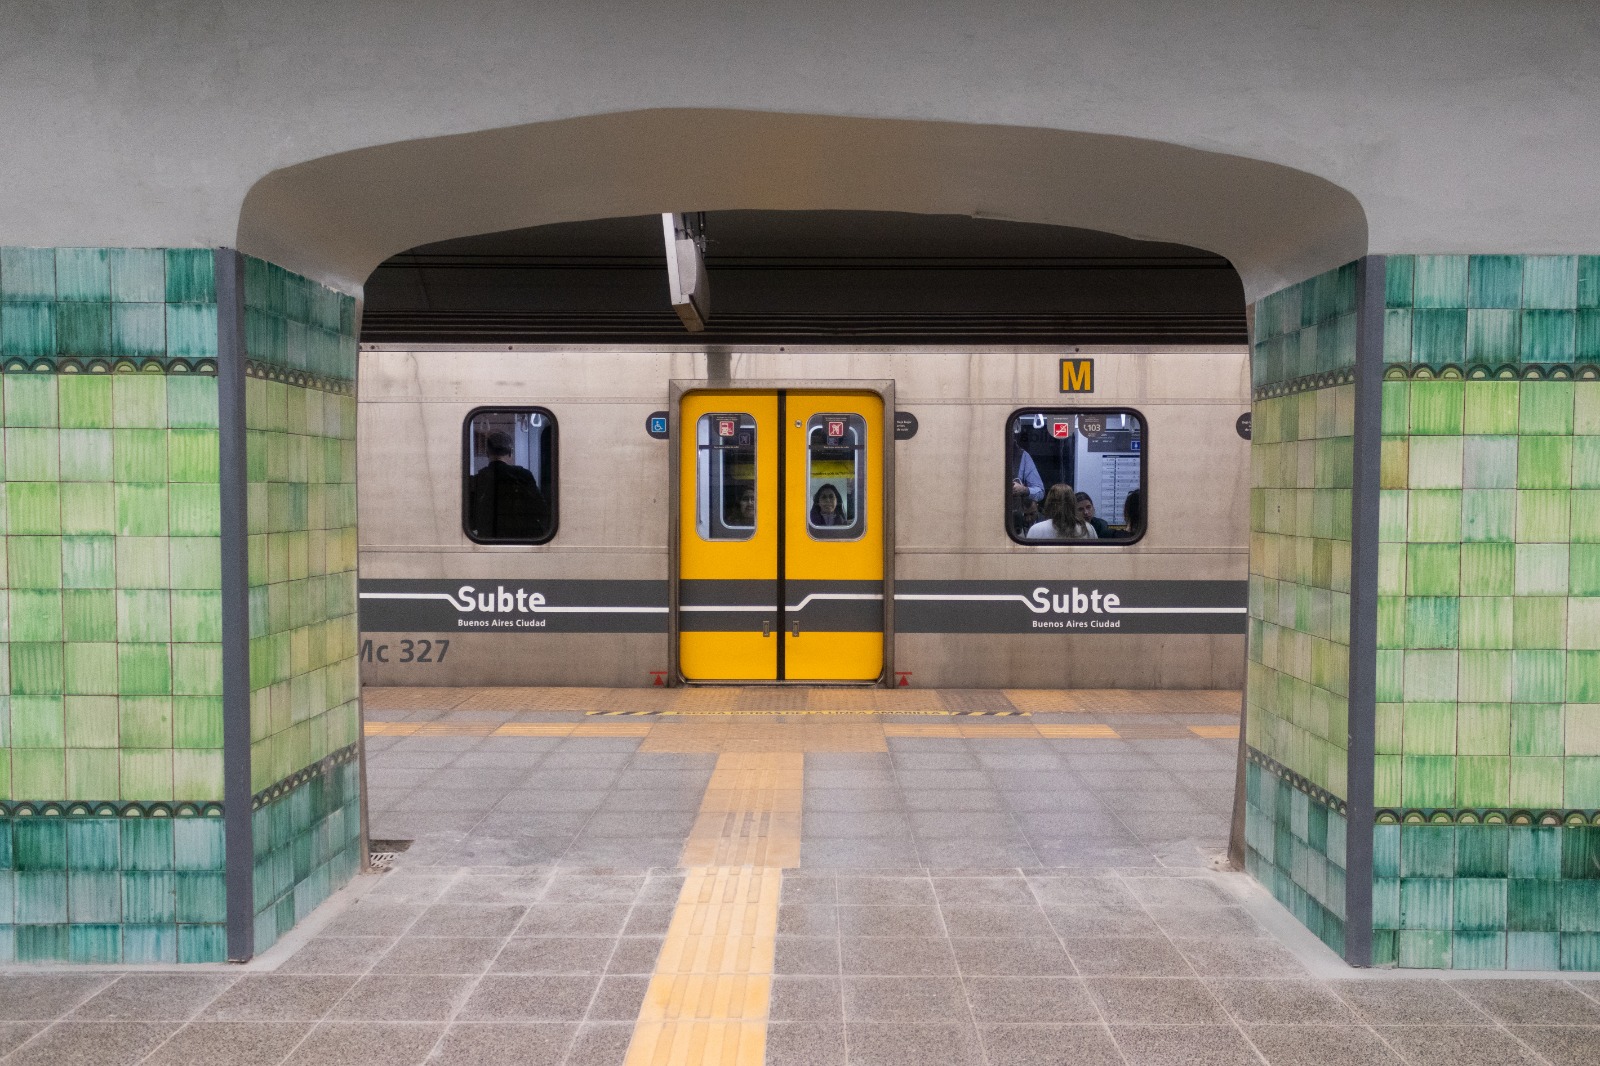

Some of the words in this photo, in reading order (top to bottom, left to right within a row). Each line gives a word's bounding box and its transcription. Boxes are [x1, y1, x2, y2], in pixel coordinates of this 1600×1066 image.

[1062, 361, 1091, 391] M
[1089, 424, 1101, 432] 103
[458, 585, 546, 613] Subte
[1032, 586, 1121, 614] Subte
[457, 619, 490, 627] Buenos
[491, 619, 514, 627] Aires
[516, 619, 546, 627] Ciudad
[1032, 620, 1064, 628] Buenos
[1066, 620, 1088, 628] Aires
[1090, 620, 1120, 628] Ciudad
[399, 639, 450, 663] 327
